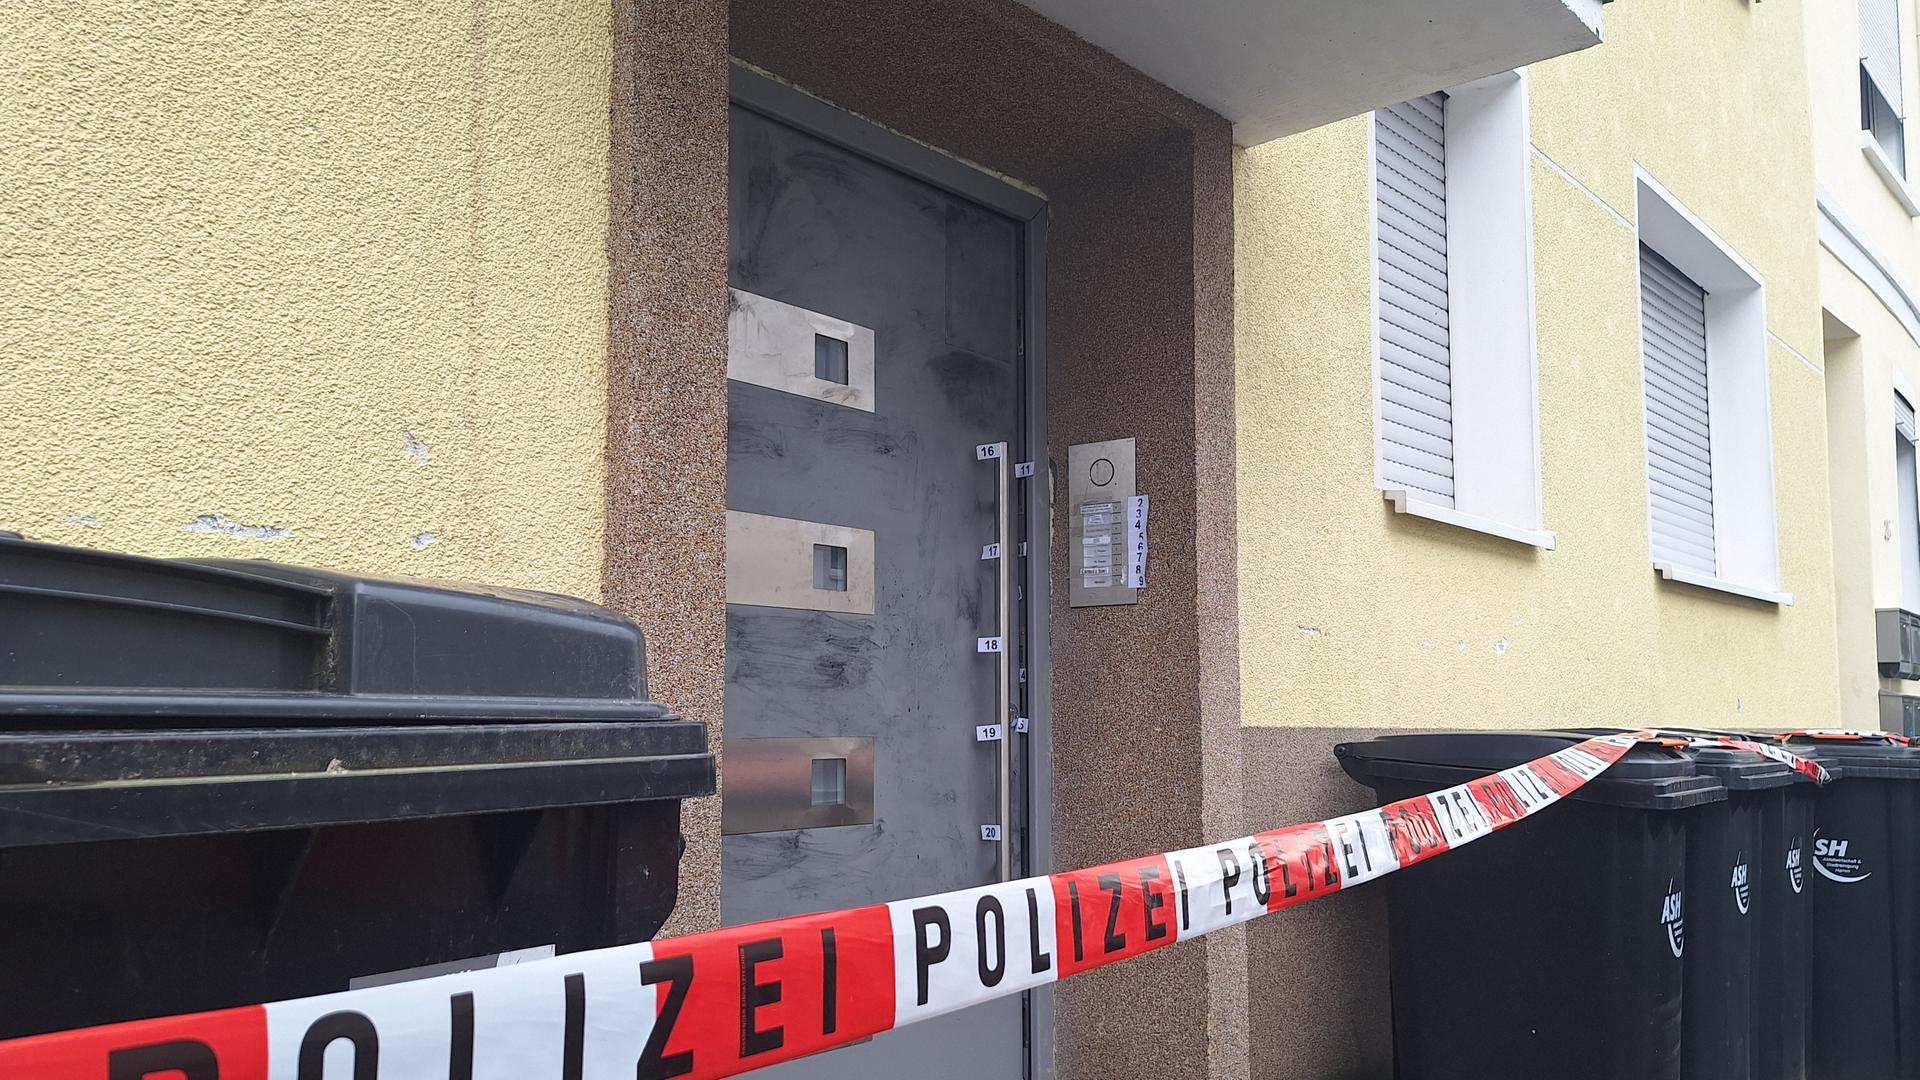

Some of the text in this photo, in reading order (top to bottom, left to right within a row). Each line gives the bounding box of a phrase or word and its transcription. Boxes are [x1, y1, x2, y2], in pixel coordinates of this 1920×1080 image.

[981, 446, 994, 456] 16
[1021, 465, 1030, 475] 11
[1138, 498, 1143, 507] 2
[1136, 509, 1141, 518] 3
[1135, 520, 1141, 529] 4
[1139, 532, 1144, 540] 5
[989, 546, 998, 556] 17
[1138, 542, 1144, 551] 6
[1137, 552, 1142, 562] 7
[1136, 565, 1141, 574] 8
[1139, 576, 1144, 586] 9
[985, 640, 997, 650] 18
[983, 728, 995, 738] 19
[986, 828, 995, 837] 20
[1814, 839, 1848, 857] SH
[1786, 848, 1801, 870] ASH
[1731, 864, 1748, 888] ASH
[1661, 891, 1682, 925] ASH
[108, 928, 836, 1080] OLIZEI
[913, 860, 1190, 1006] POLIZEI
[1217, 820, 1372, 915] POLIZEI
